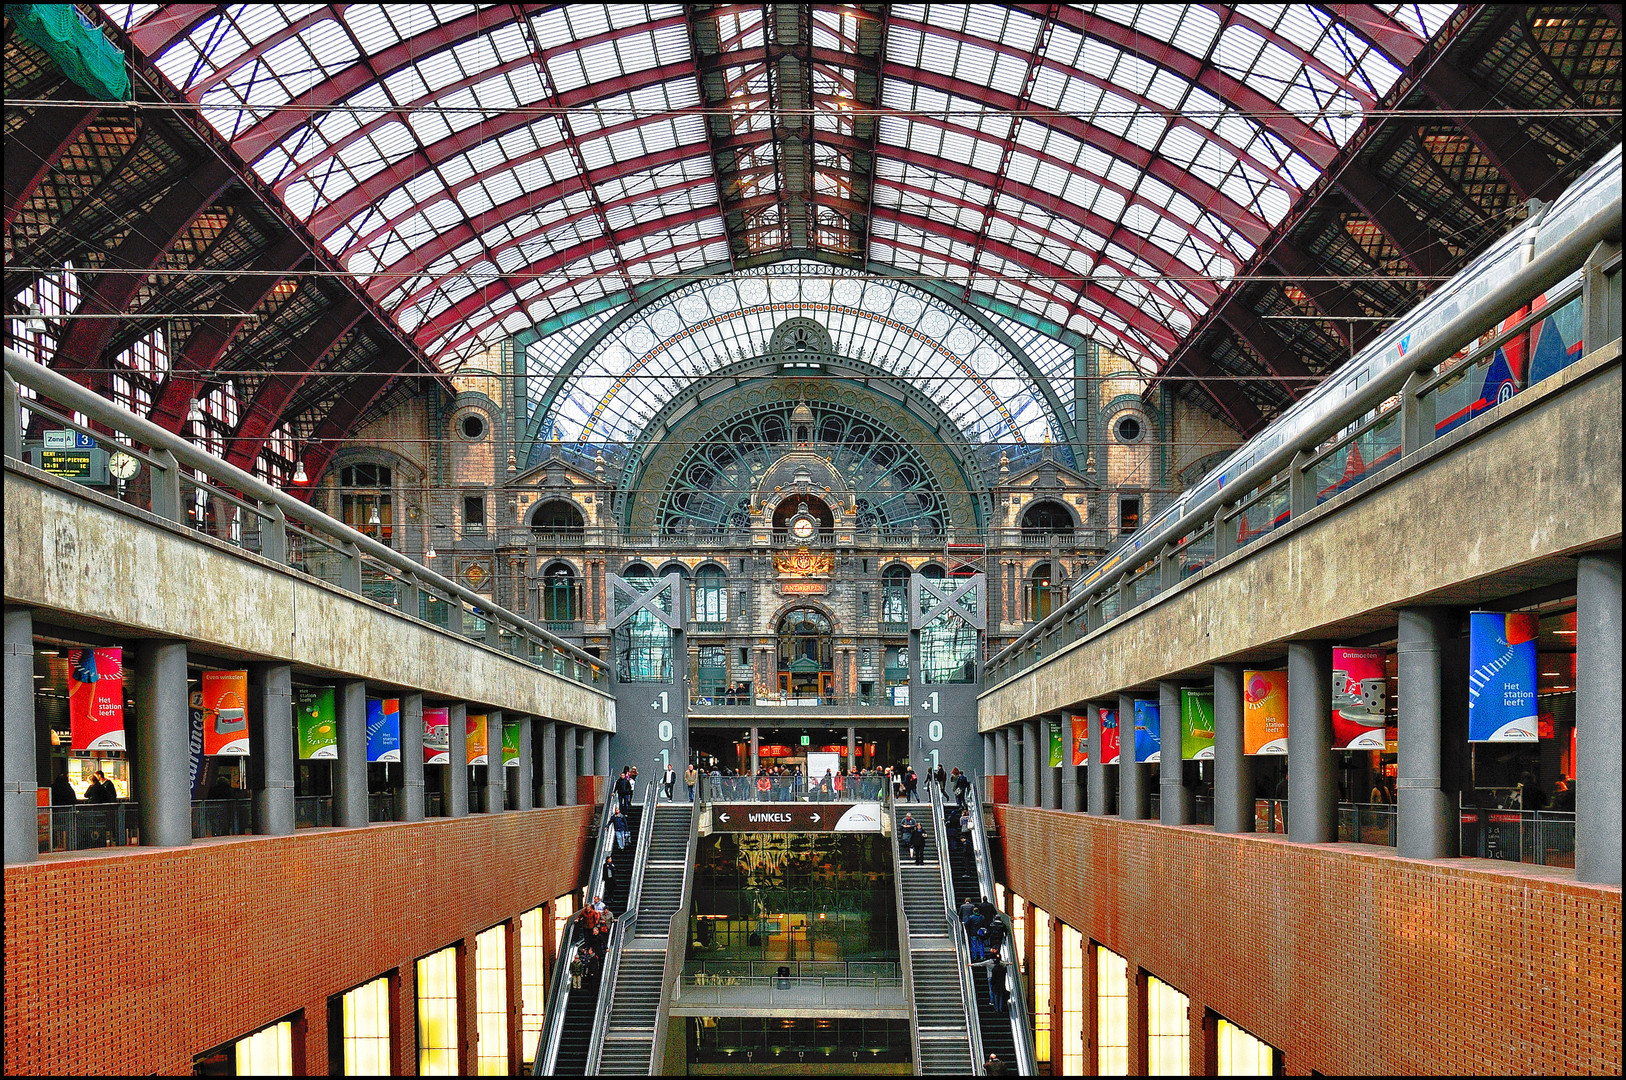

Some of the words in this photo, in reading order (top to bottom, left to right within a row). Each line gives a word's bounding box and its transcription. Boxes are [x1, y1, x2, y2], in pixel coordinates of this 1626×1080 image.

[81, 434, 89, 445] 3
[1503, 690, 1534, 698] station
[1504, 682, 1520, 690] Het
[650, 691, 668, 714] +1
[921, 691, 939, 714] +1
[1503, 698, 1525, 706] leeft
[658, 720, 673, 742] 0
[928, 720, 943, 742] 0
[653, 748, 669, 771] -1
[923, 748, 939, 771] -1
[748, 813, 792, 823] WINKELS
